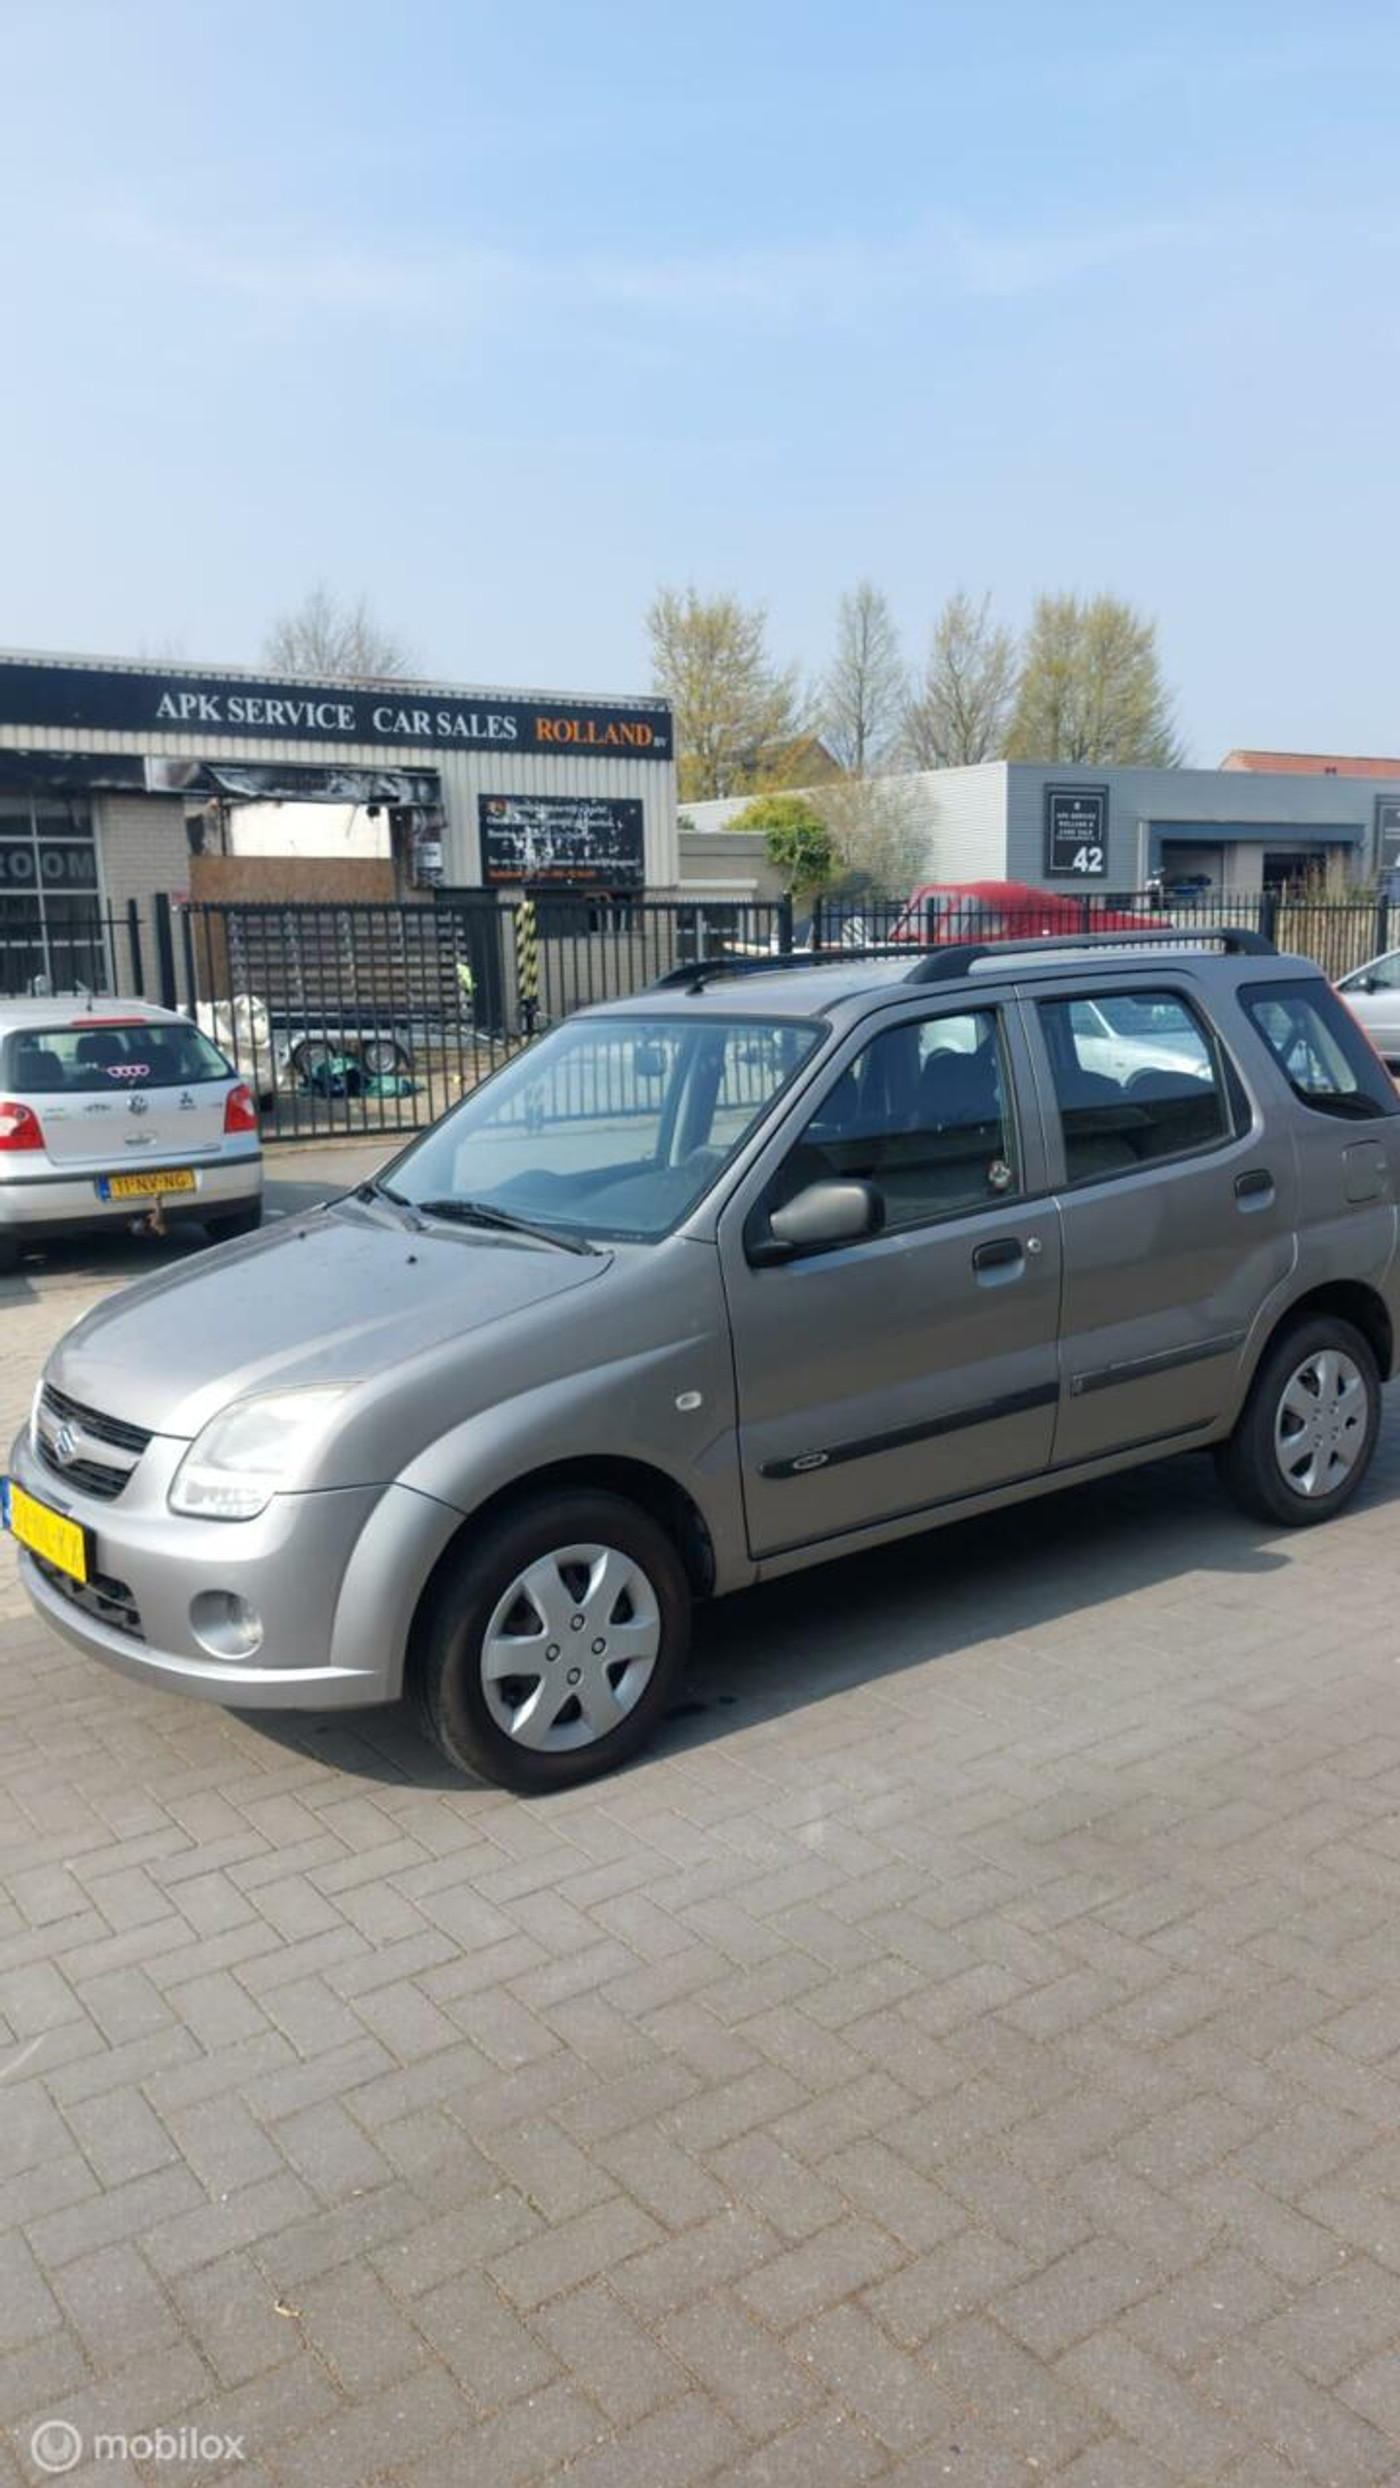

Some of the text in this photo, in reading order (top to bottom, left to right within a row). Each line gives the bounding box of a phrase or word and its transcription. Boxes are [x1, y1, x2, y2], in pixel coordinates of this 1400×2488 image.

[156, 692, 221, 721] APK
[227, 696, 356, 730] SERVICE
[372, 706, 432, 735] CAR
[437, 711, 518, 740] SALES
[535, 716, 653, 747] ROLLAND
[0, 851, 95, 879] OOM
[1072, 846, 1103, 872] 42
[117, 1172, 188, 1195] 11-NV-NG
